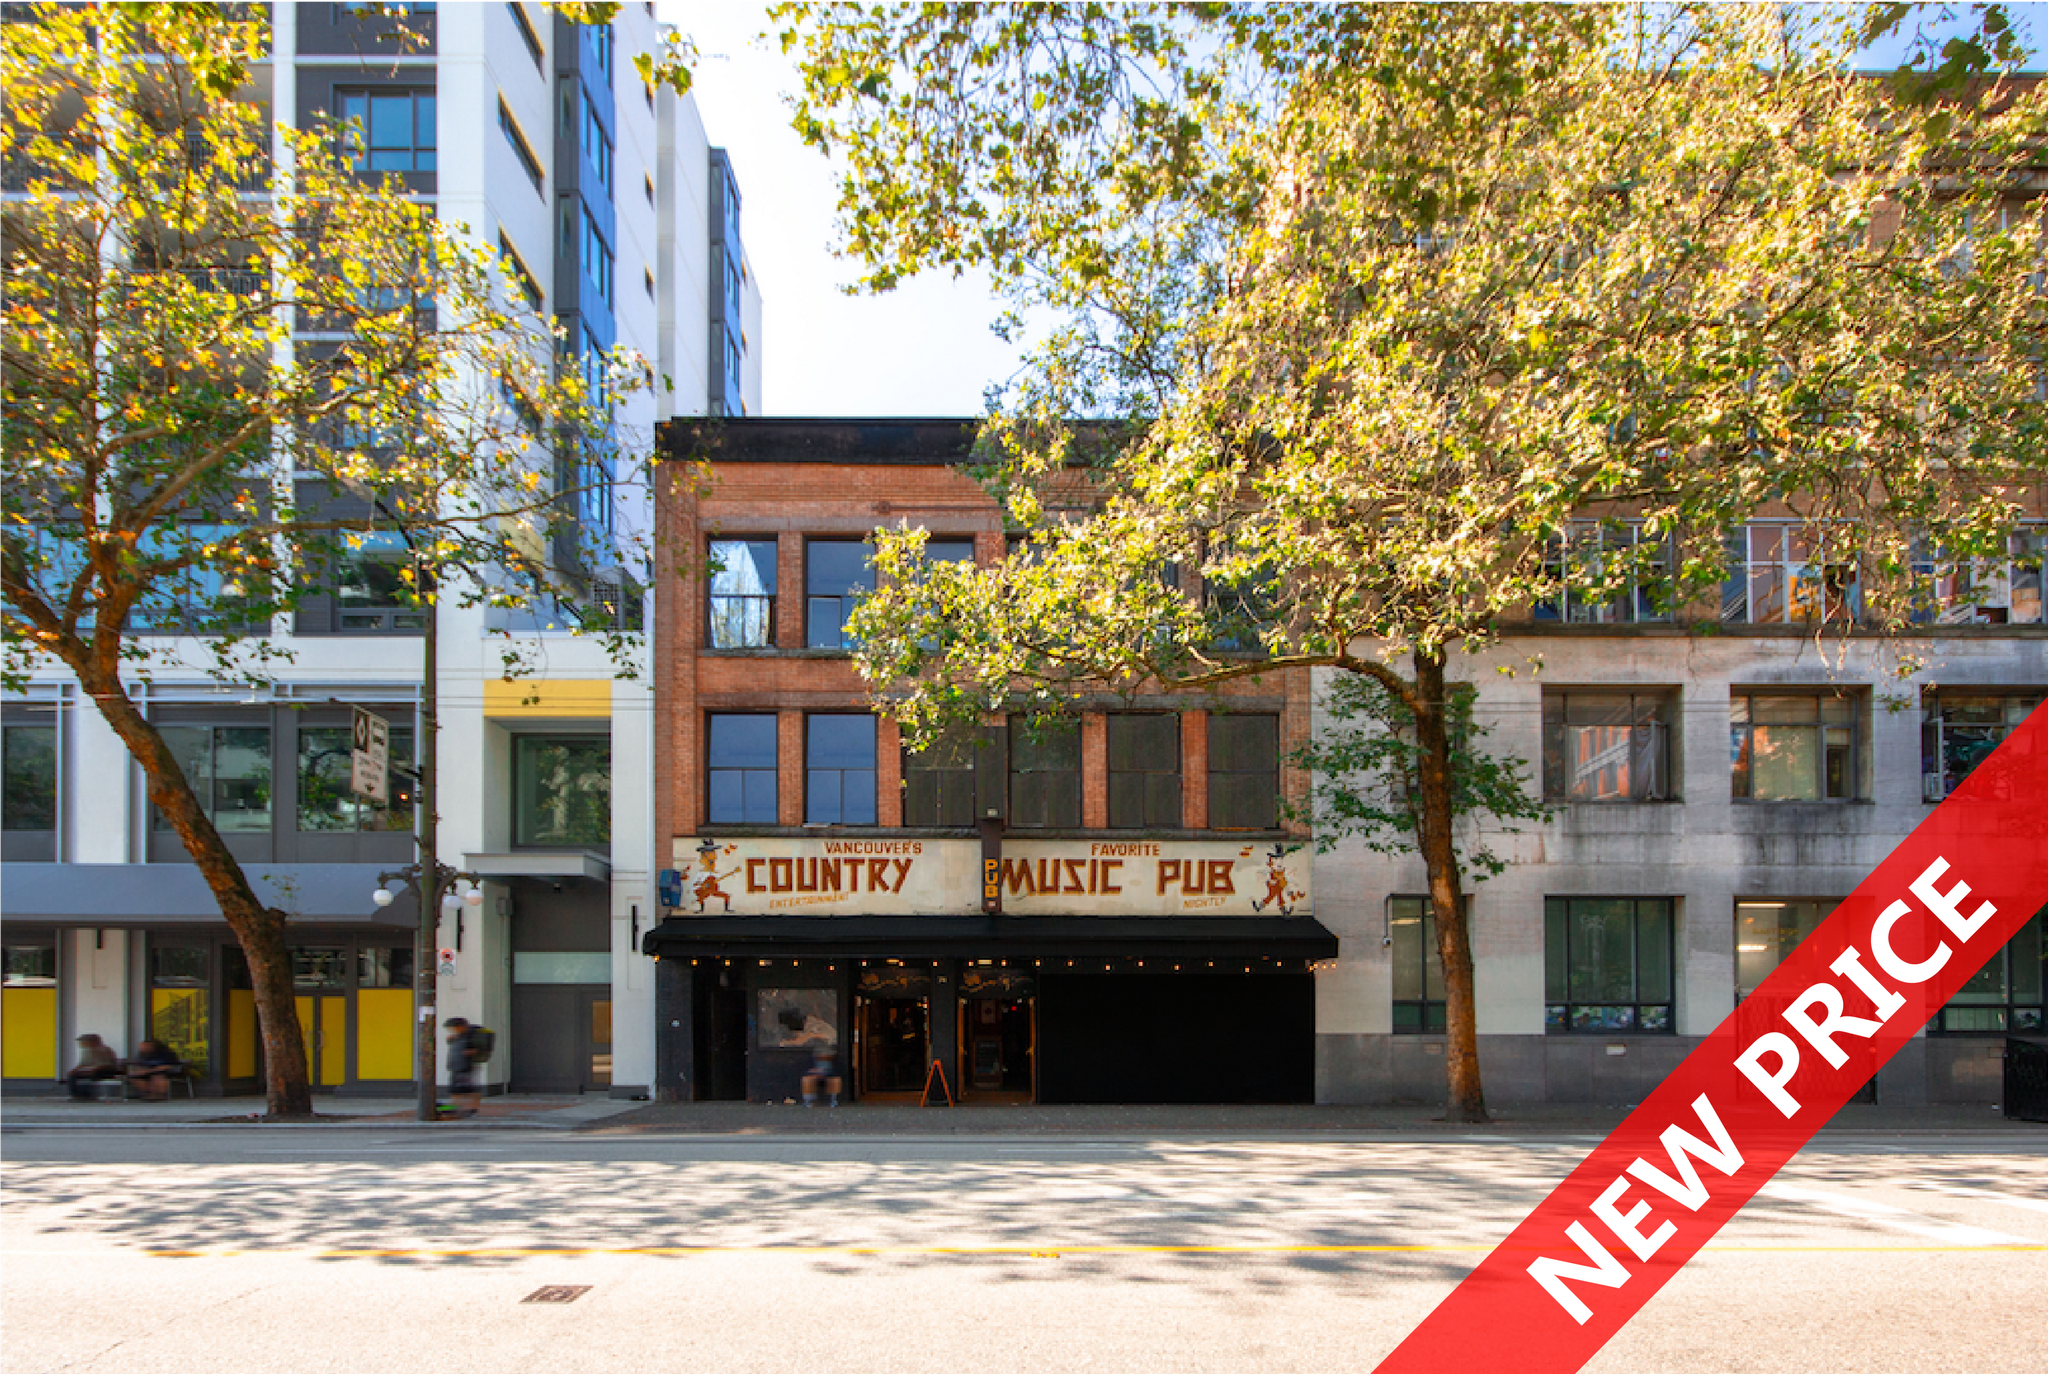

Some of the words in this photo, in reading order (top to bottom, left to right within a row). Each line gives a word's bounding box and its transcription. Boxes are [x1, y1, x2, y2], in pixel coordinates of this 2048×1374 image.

[824, 840, 922, 856] VANCOUVER'S
[1091, 842, 1160, 857] FAVORITE
[745, 857, 913, 894] COUNTRY
[1001, 858, 1124, 896] MUSIC
[1156, 859, 1236, 896] PUB
[984, 858, 999, 898] PUB
